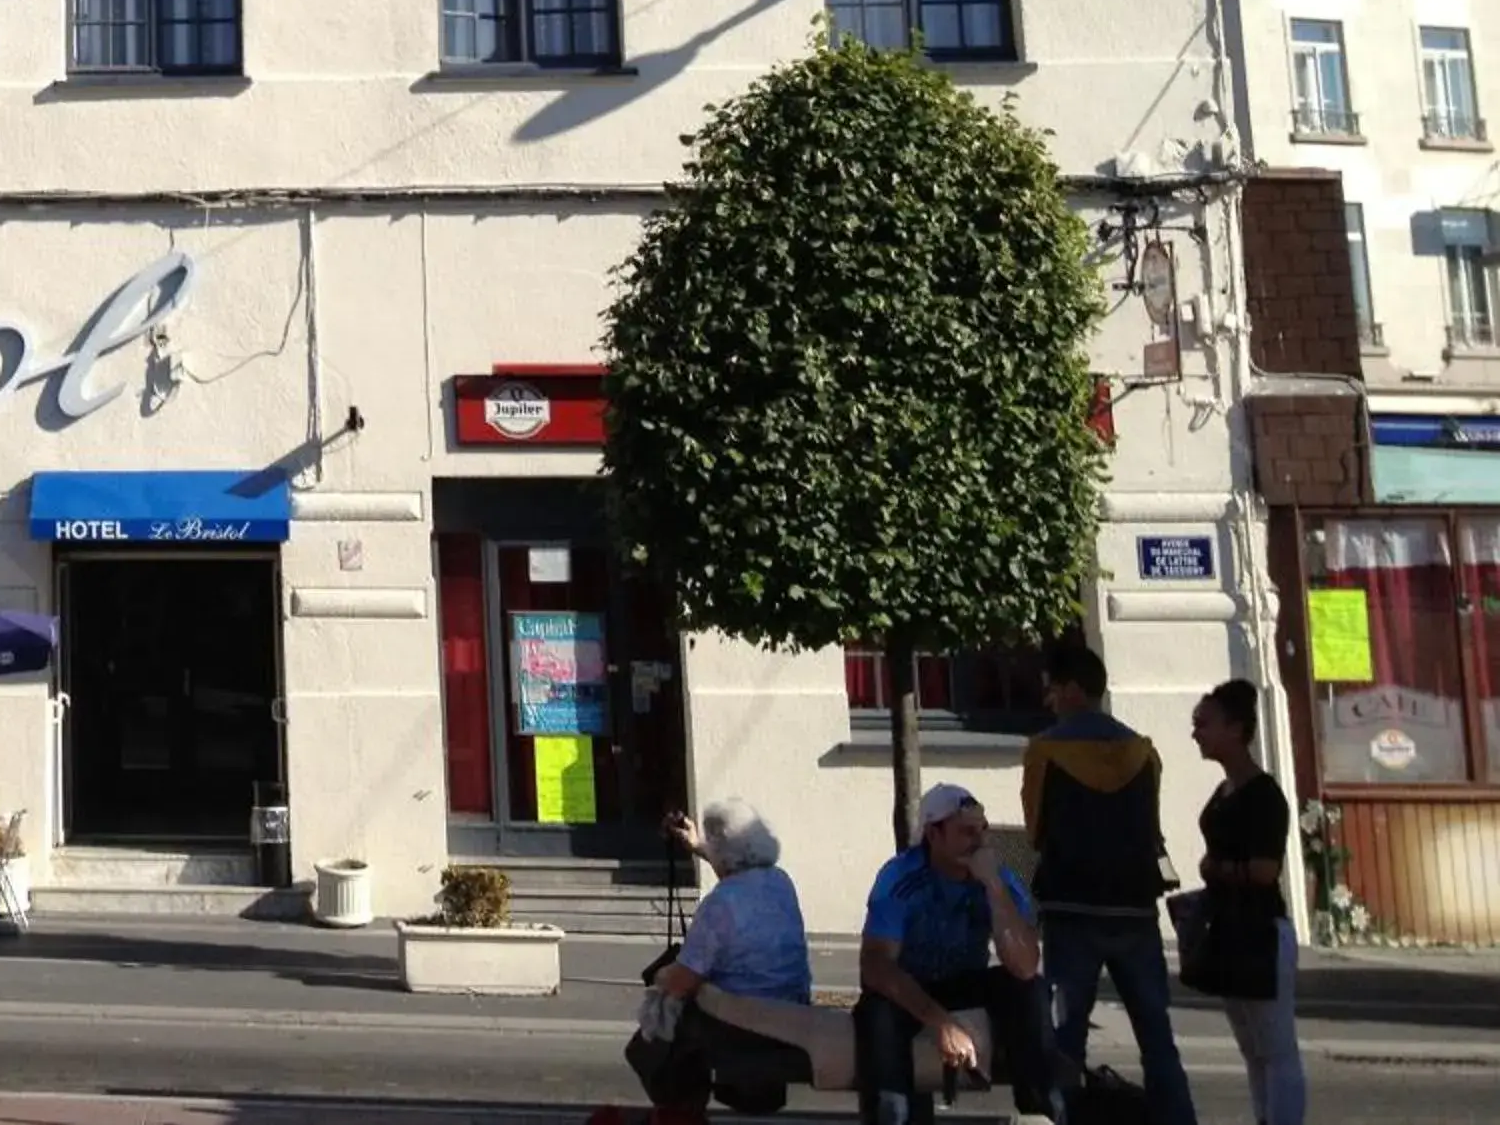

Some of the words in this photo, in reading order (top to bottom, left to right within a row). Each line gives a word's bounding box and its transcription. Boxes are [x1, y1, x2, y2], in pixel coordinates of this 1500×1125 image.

[494, 402, 544, 419] Jupiler
[56, 521, 128, 539] HOTEL
[150, 522, 173, 540] Le
[174, 513, 250, 540] Bristol
